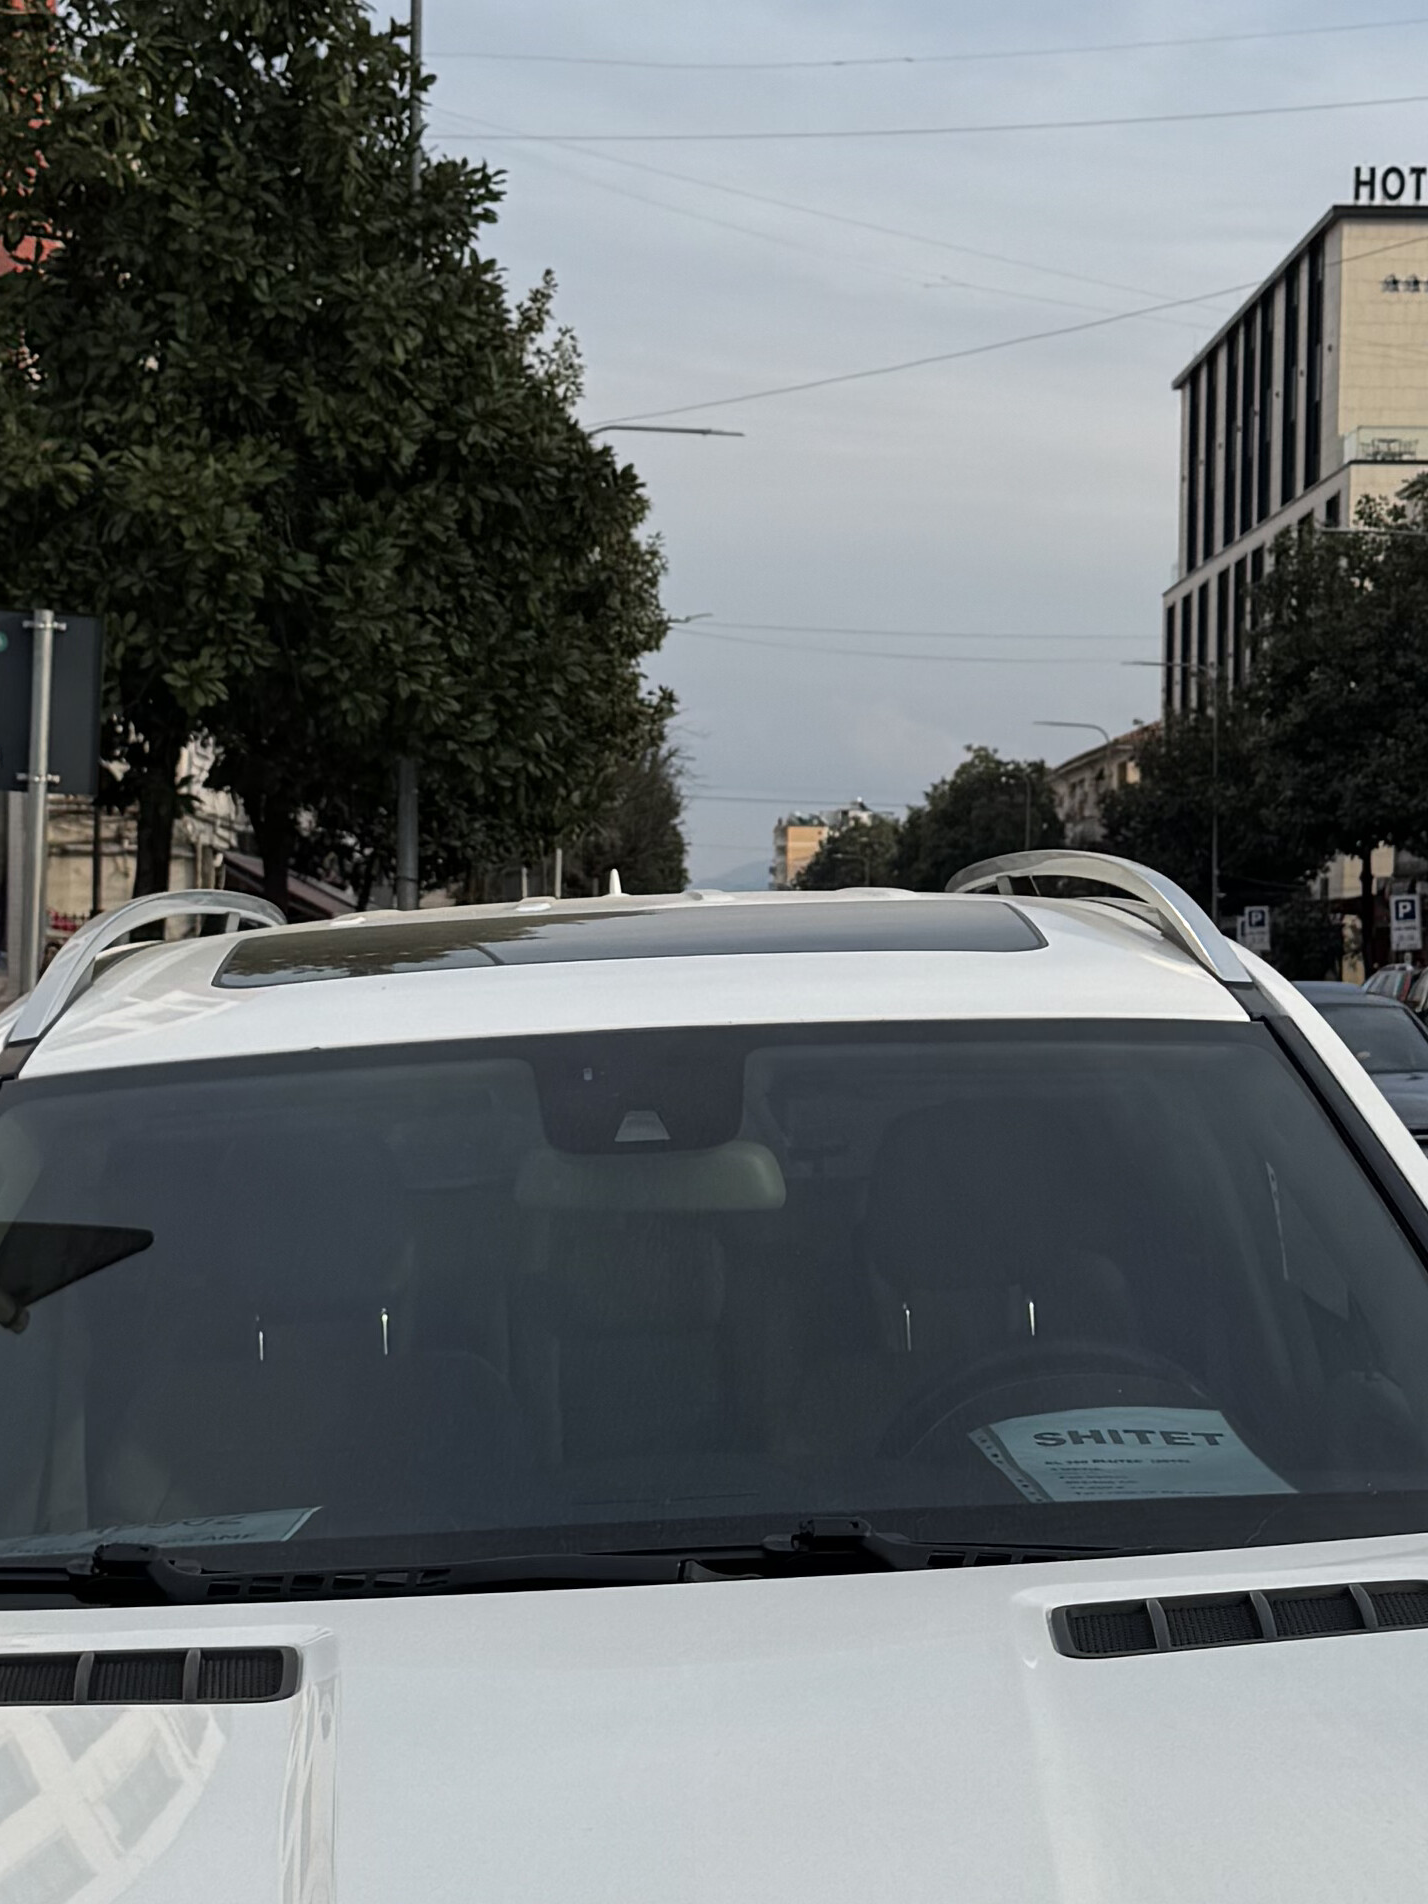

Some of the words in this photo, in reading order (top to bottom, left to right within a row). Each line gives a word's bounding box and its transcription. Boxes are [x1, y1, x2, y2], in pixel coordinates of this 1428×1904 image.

[1250, 910, 1263, 926] P
[1398, 900, 1412, 919] P
[1032, 1428, 1224, 1447] SHITET
